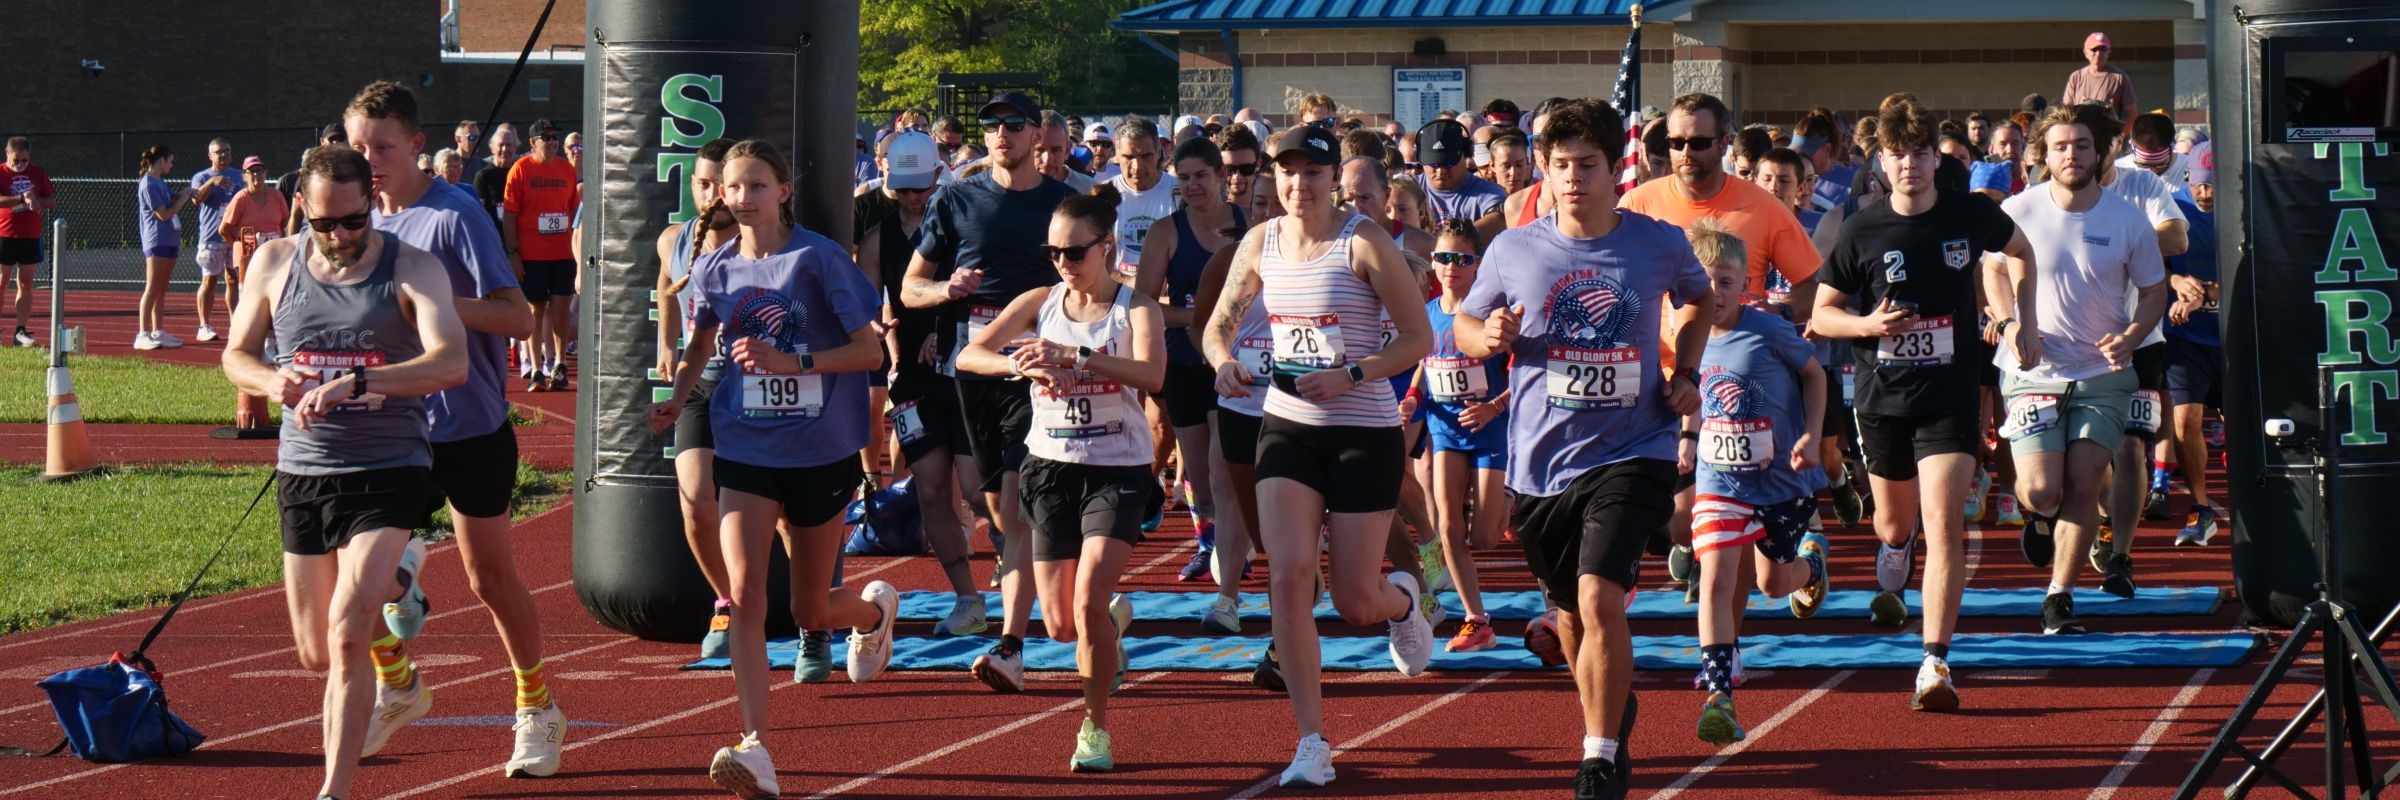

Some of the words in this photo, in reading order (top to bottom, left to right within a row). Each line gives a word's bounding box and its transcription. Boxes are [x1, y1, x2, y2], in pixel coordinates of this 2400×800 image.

[548, 218, 560, 229] 28
[1883, 250, 1907, 283] 2
[1550, 271, 1577, 294] GLORY
[1580, 268, 1594, 279] 5K
[2313, 142, 2400, 446] TART
[981, 308, 994, 317] OLD
[1929, 319, 1938, 329] 5K
[303, 329, 376, 350] SVRC
[1253, 339, 1265, 348] OLD
[1291, 328, 1319, 354] 26
[1893, 332, 1934, 358] 233
[309, 355, 326, 365] OLD
[326, 356, 353, 366] GLORY
[354, 356, 367, 366] 5K
[1259, 351, 1272, 375] 3
[1565, 350, 1582, 361] OLD
[1583, 351, 1610, 362] GLORY
[1611, 351, 1623, 360] 5K
[758, 378, 799, 406] 199
[1070, 384, 1091, 393] LORY
[1092, 384, 1104, 393] 5K
[1437, 369, 1469, 393] 119
[1566, 364, 1616, 397] 228
[1065, 397, 1093, 425] 49
[1744, 422, 1756, 431] 5K
[1713, 435, 1753, 462] 203
